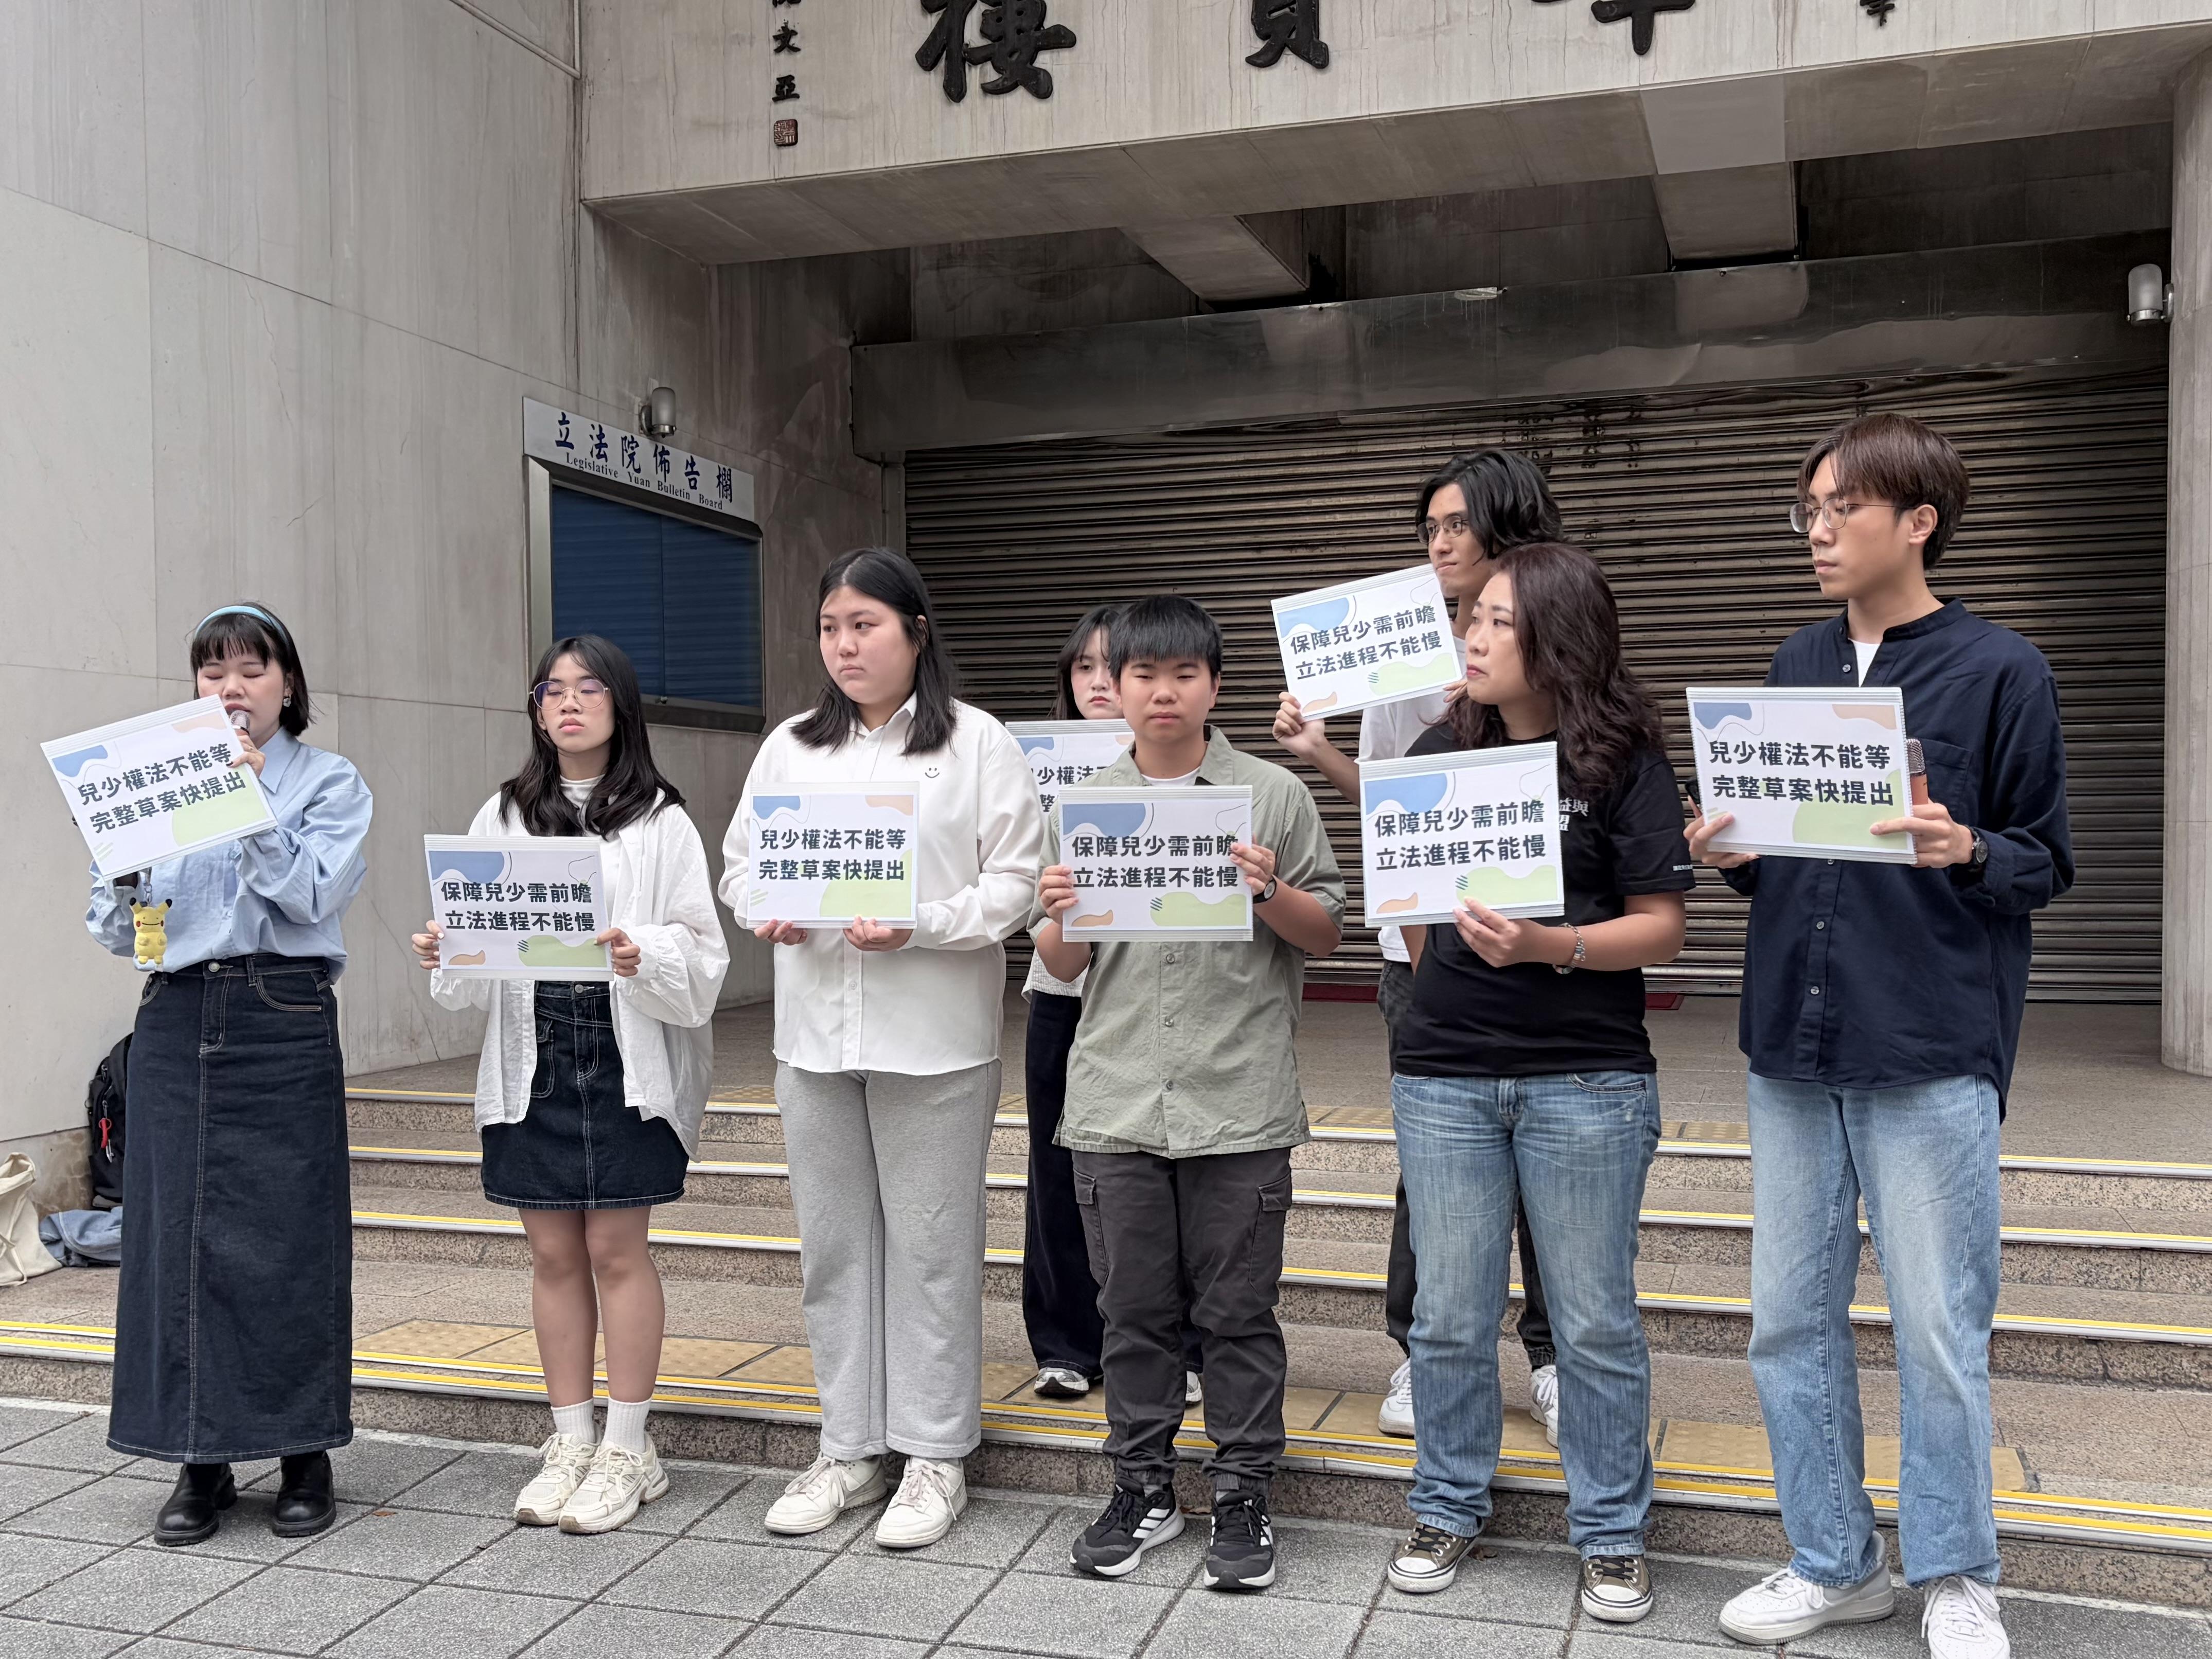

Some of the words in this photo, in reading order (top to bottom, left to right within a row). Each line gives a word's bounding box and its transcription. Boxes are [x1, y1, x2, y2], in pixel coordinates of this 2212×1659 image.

[772, 0, 801, 102] 文亞
[555, 412, 733, 503] 立法院佈告欄
[567, 452, 618, 478] Legislative
[627, 472, 650, 488] Yuan
[657, 480, 691, 500] Bulletin
[699, 493, 722, 510] Board
[1290, 605, 1436, 655] 保障兒少需前瞻
[1296, 630, 1442, 680] 立法進程不能慢
[1709, 740, 1890, 770] 兒少權法不能等
[78, 743, 233, 805] 兒少權法不能等
[1031, 765, 1107, 785] 少權法
[1712, 774, 1894, 806] 完整草案快提出
[90, 771, 246, 833] 完整草案快提出
[1375, 799, 1544, 838] 保障兒少需前瞻
[759, 828, 906, 850] 兒少權法不能等
[1376, 834, 1546, 871] 立法進程不能慢
[759, 859, 904, 880] 完整草案快提出
[1073, 866, 1238, 888] 立法進程不能慢
[441, 881, 592, 904] 保障兒少需前瞻
[445, 910, 595, 932] 立法進程不能慢
